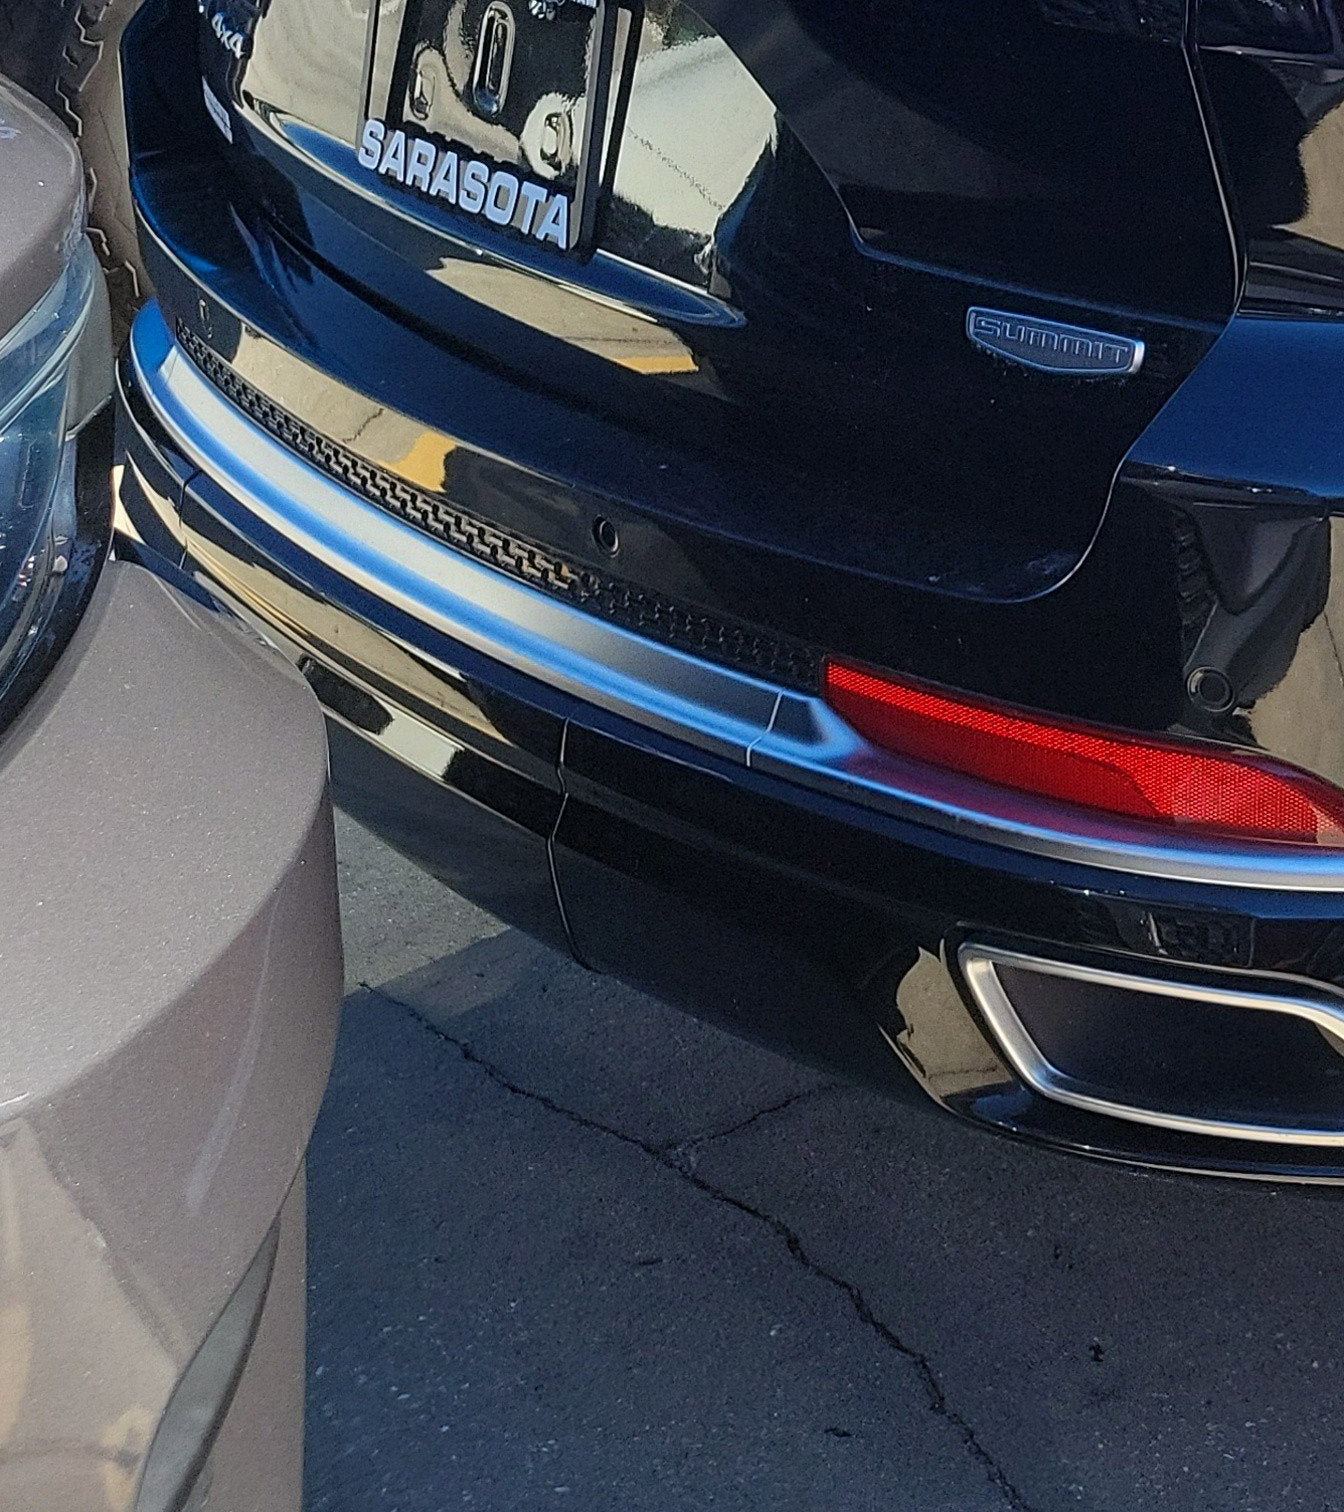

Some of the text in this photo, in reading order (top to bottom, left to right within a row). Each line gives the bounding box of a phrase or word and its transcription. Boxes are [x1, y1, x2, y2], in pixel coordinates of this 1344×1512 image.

[211, 11, 246, 60] 4x4
[358, 118, 569, 251] SARASOTA
[974, 316, 1129, 364] SUMMIT
